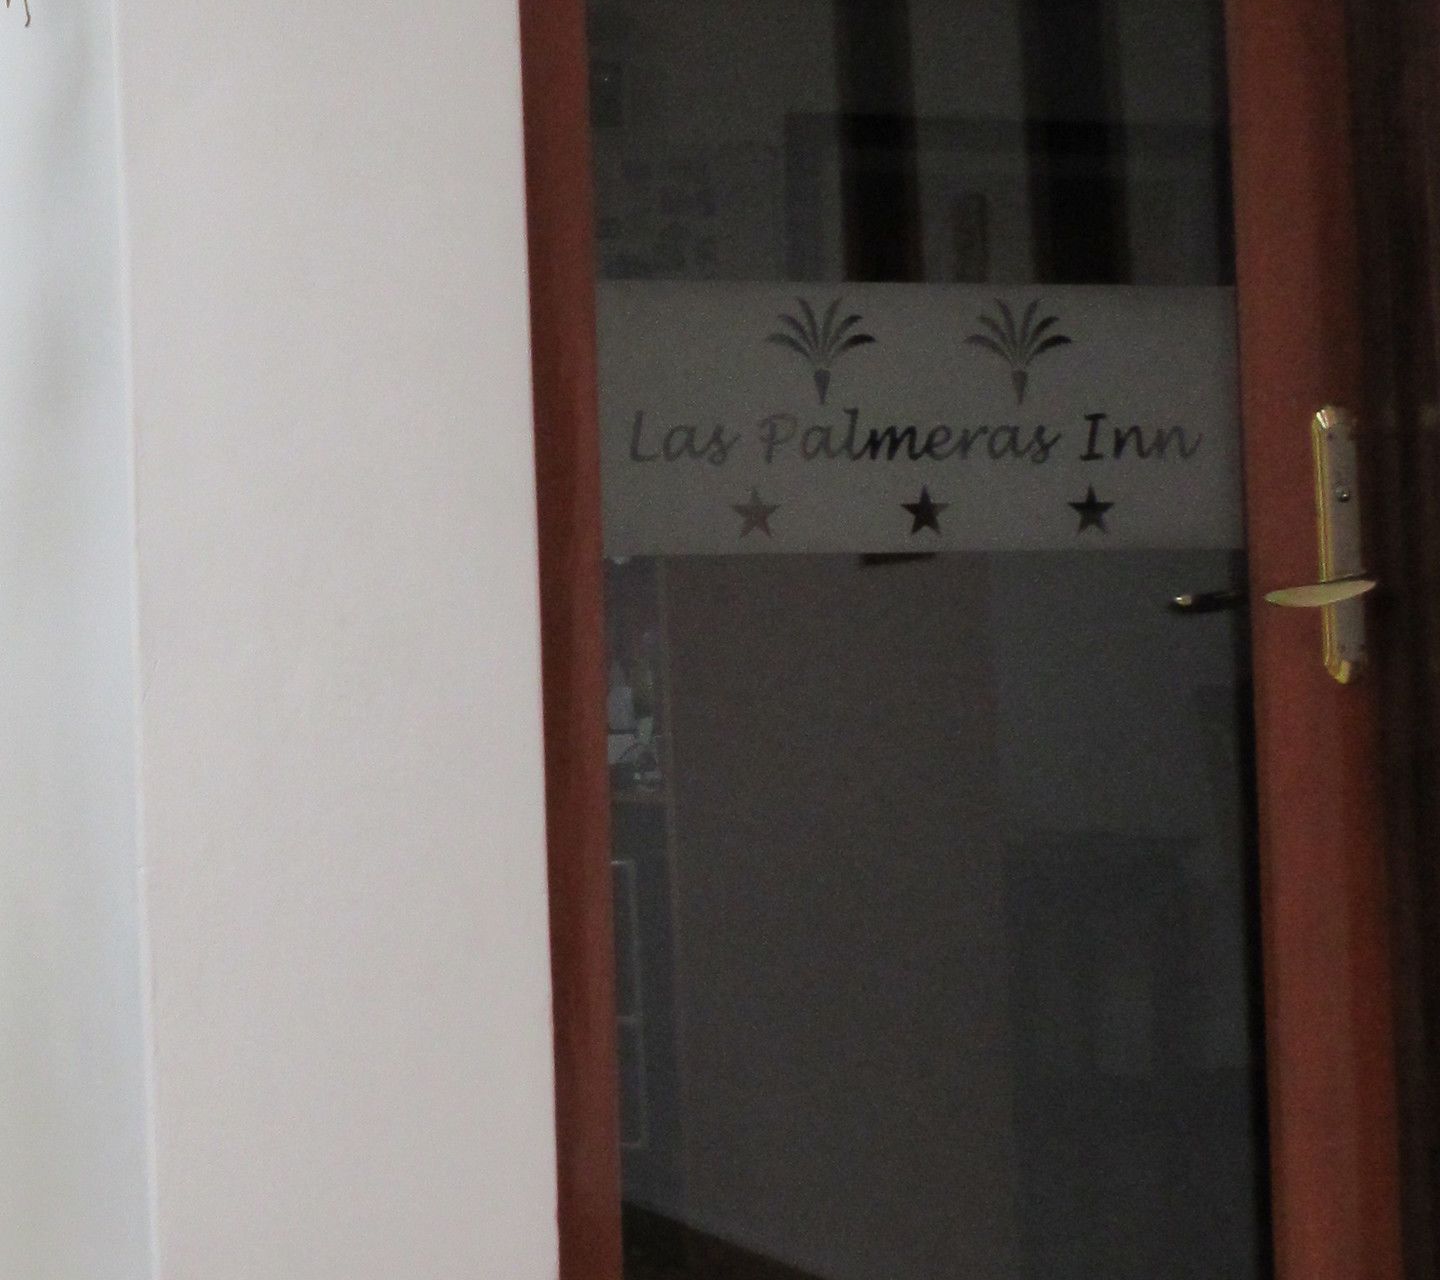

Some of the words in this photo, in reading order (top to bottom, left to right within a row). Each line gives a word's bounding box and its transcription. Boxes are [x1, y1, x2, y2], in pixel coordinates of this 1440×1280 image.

[628, 410, 741, 465] Las
[761, 408, 1060, 463] Palmeras
[1078, 412, 1202, 462] Inn
